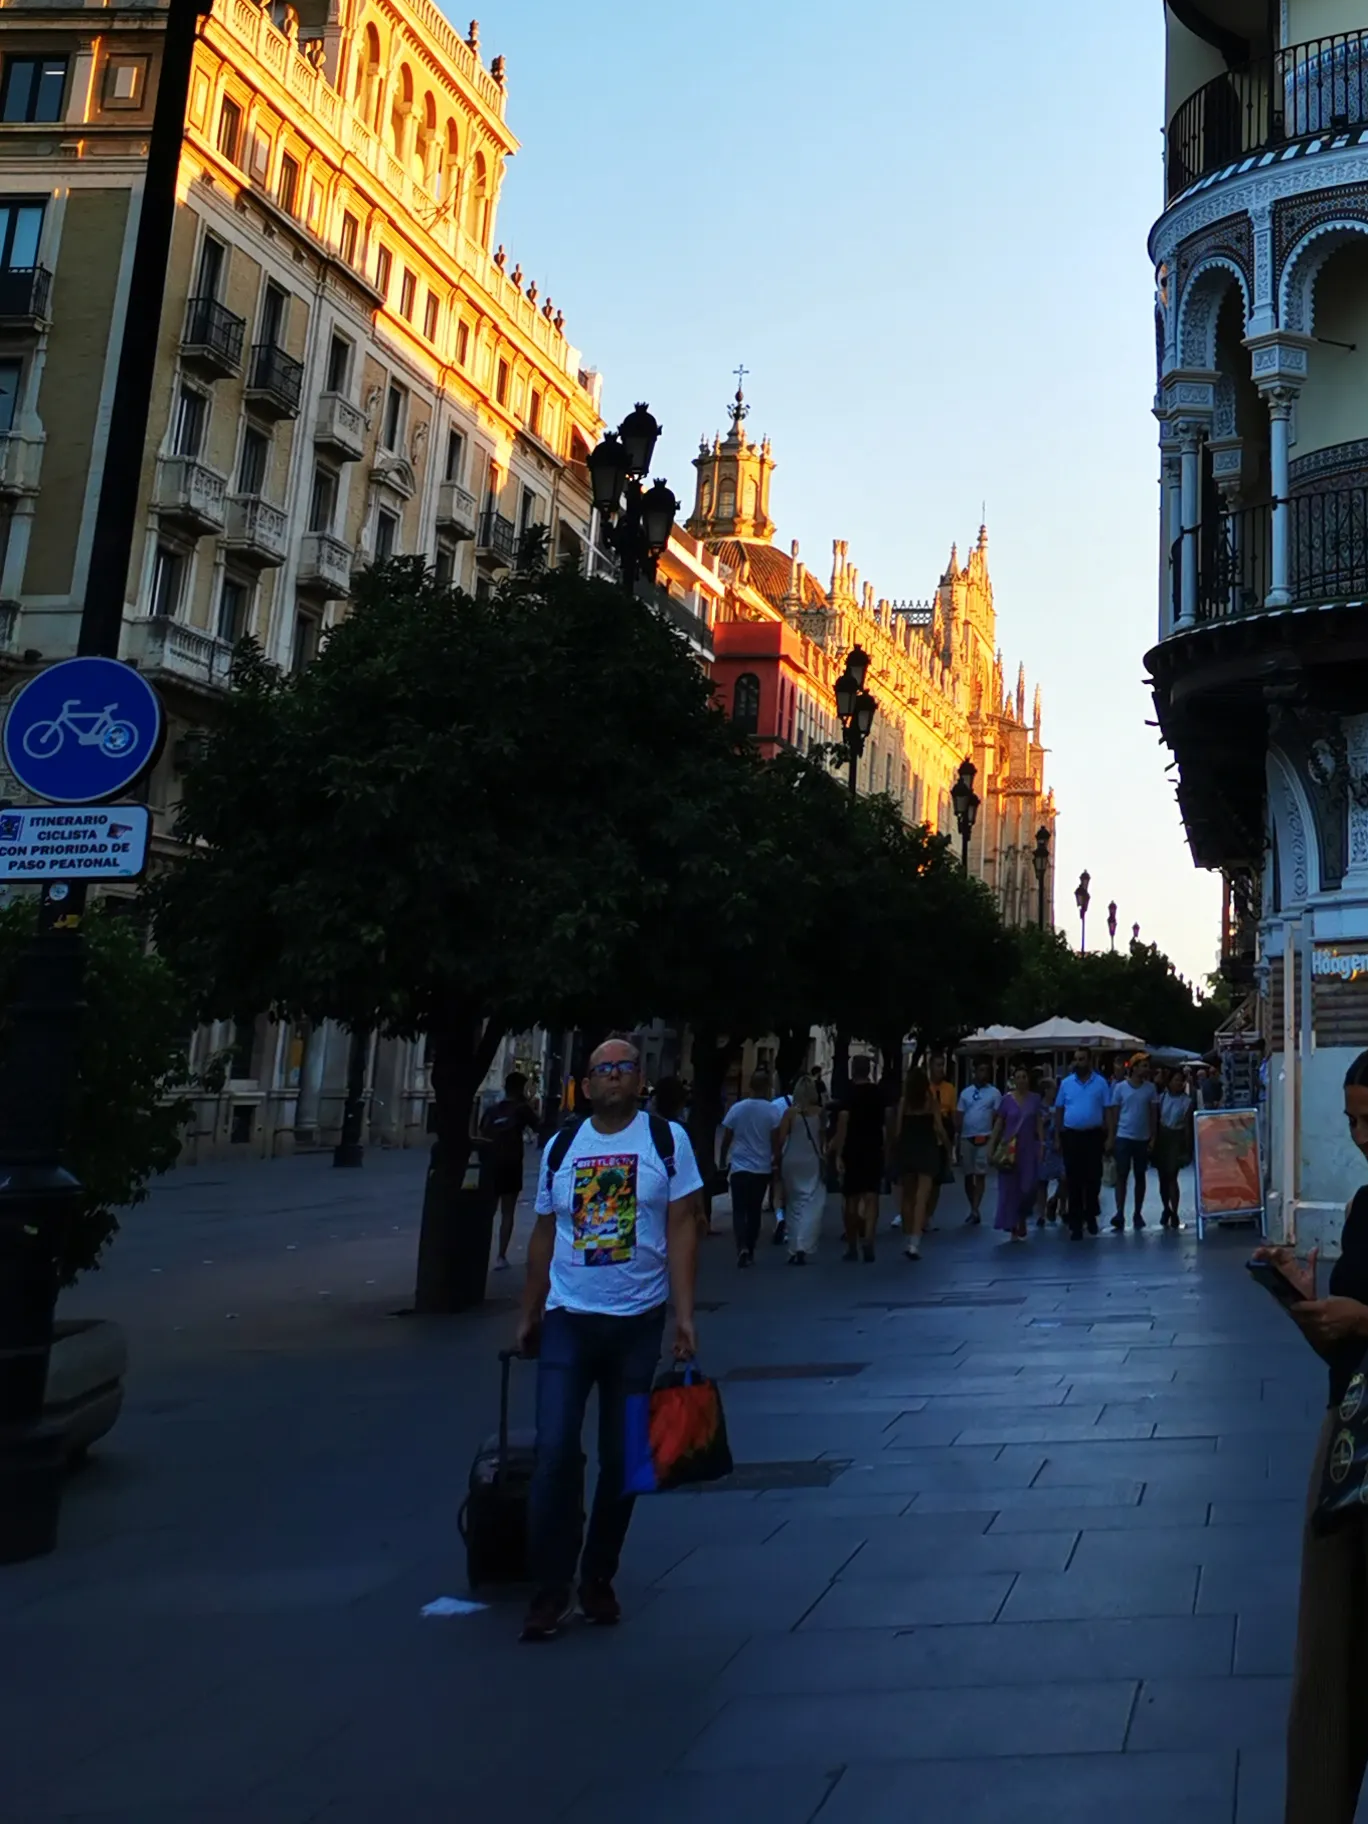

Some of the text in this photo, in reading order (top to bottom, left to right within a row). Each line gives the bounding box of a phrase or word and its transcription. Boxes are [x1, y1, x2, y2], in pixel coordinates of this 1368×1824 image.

[30, 815, 108, 827] ITINERARIO
[37, 830, 97, 841] CICLISTA
[0, 843, 130, 856] CON PRIORIDAD DE
[8, 858, 120, 870] PASO PEATONAL
